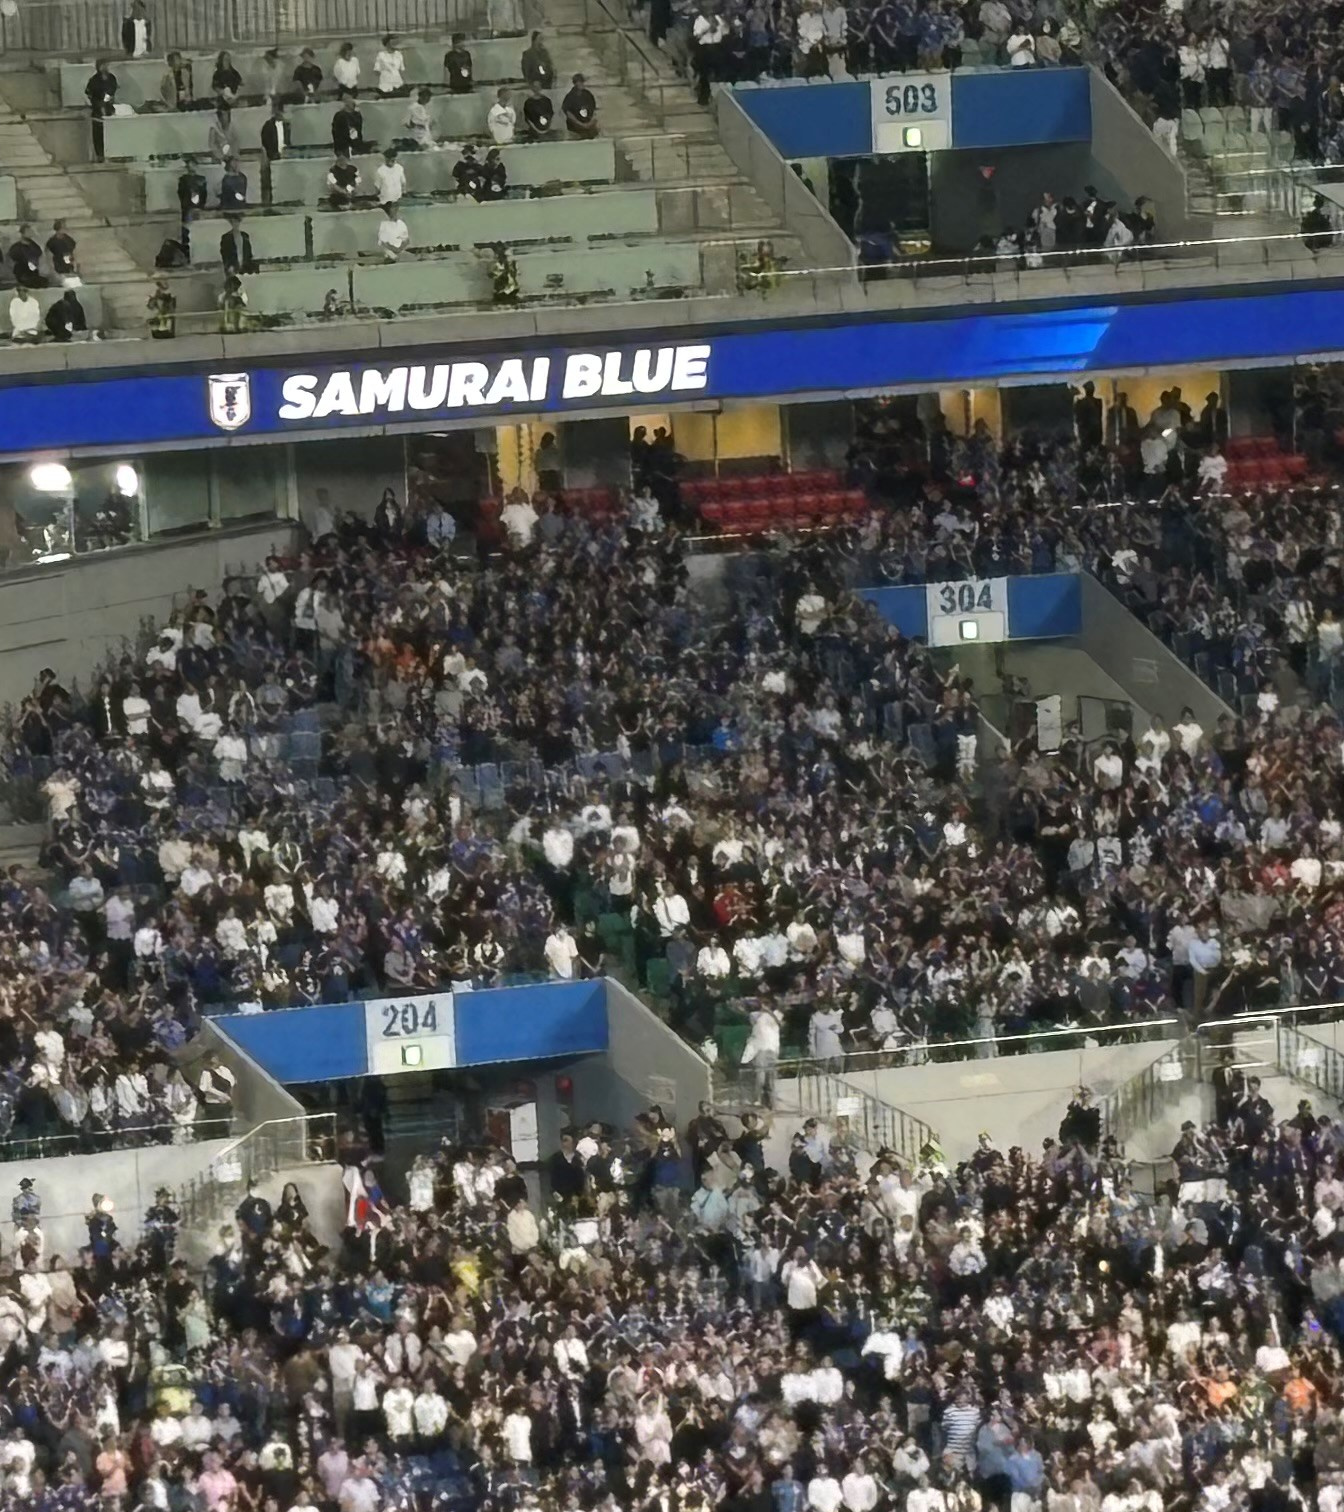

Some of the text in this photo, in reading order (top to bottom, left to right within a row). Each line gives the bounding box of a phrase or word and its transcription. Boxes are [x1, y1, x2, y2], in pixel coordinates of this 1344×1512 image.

[885, 83, 937, 115] 503
[278, 344, 712, 420] SAMURAI BLUE
[940, 584, 992, 614] 304
[382, 1001, 436, 1037] 204
